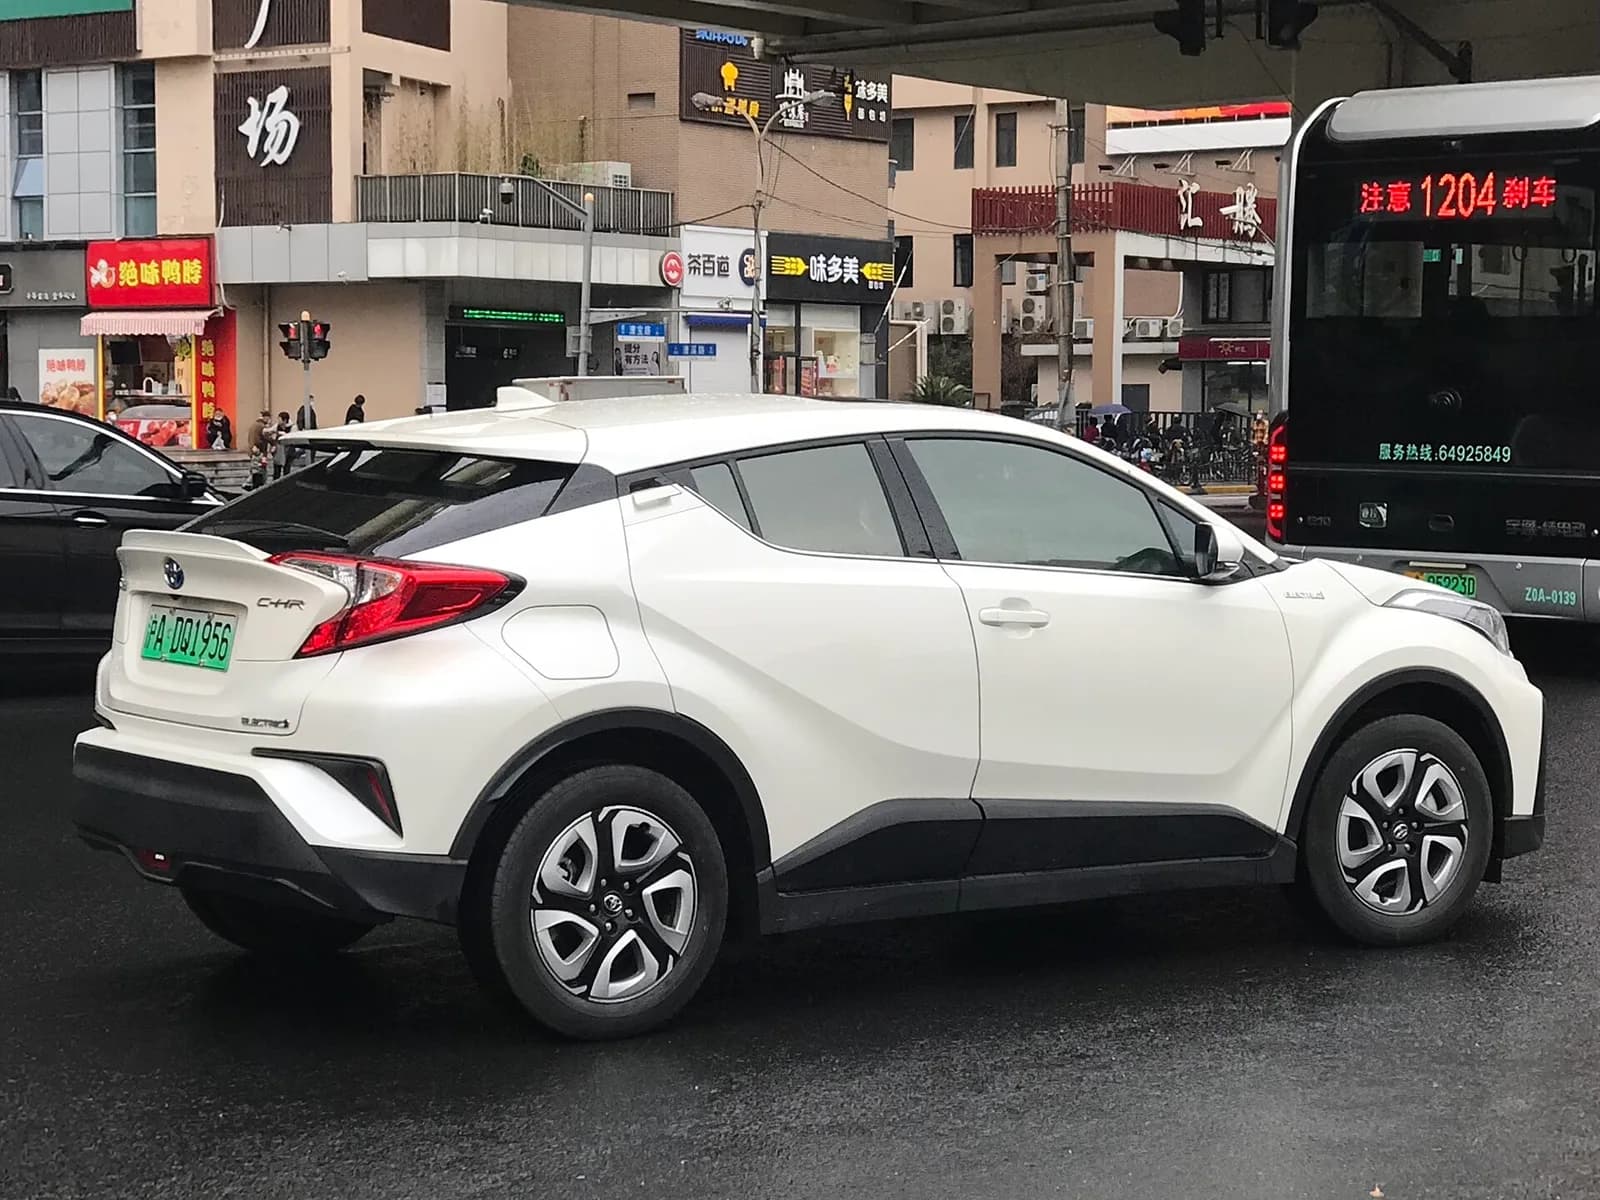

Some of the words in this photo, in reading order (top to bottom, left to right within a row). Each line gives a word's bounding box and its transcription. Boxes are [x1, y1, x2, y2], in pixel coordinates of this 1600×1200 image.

[238, 85, 301, 167] 场
[1360, 181, 1412, 213] 注意
[1421, 171, 1497, 218] 1204
[1502, 175, 1557, 209] 刹车
[118, 258, 203, 287] 绝味鸭脖
[687, 253, 730, 277] 茶百道
[809, 253, 860, 285] 味多美
[624, 354, 649, 365] 有方法
[201, 339, 215, 420] 绝味鸭脖
[257, 597, 305, 611] C-HR
[169, 616, 232, 661] DQ1956
